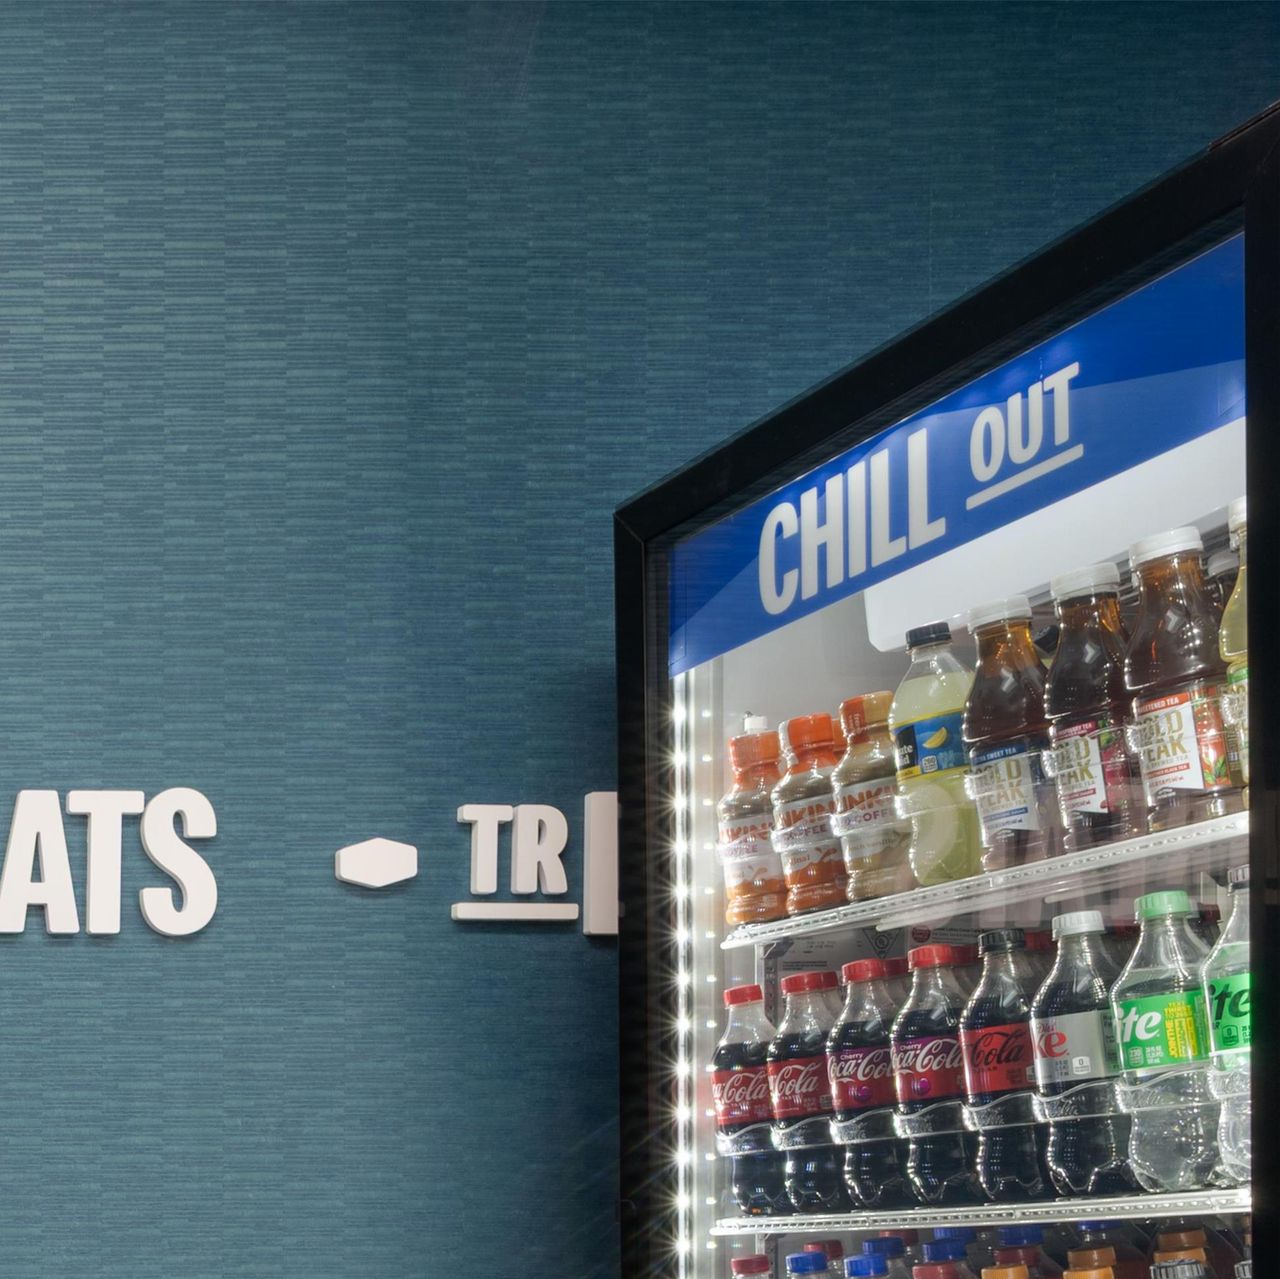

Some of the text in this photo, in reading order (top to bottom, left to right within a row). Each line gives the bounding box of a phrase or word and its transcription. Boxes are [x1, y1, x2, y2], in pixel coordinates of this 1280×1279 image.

[758, 361, 1080, 616] CHILL OUT
[900, 1042, 921, 1051] Cherry
[840, 1051, 863, 1060] Cherry
